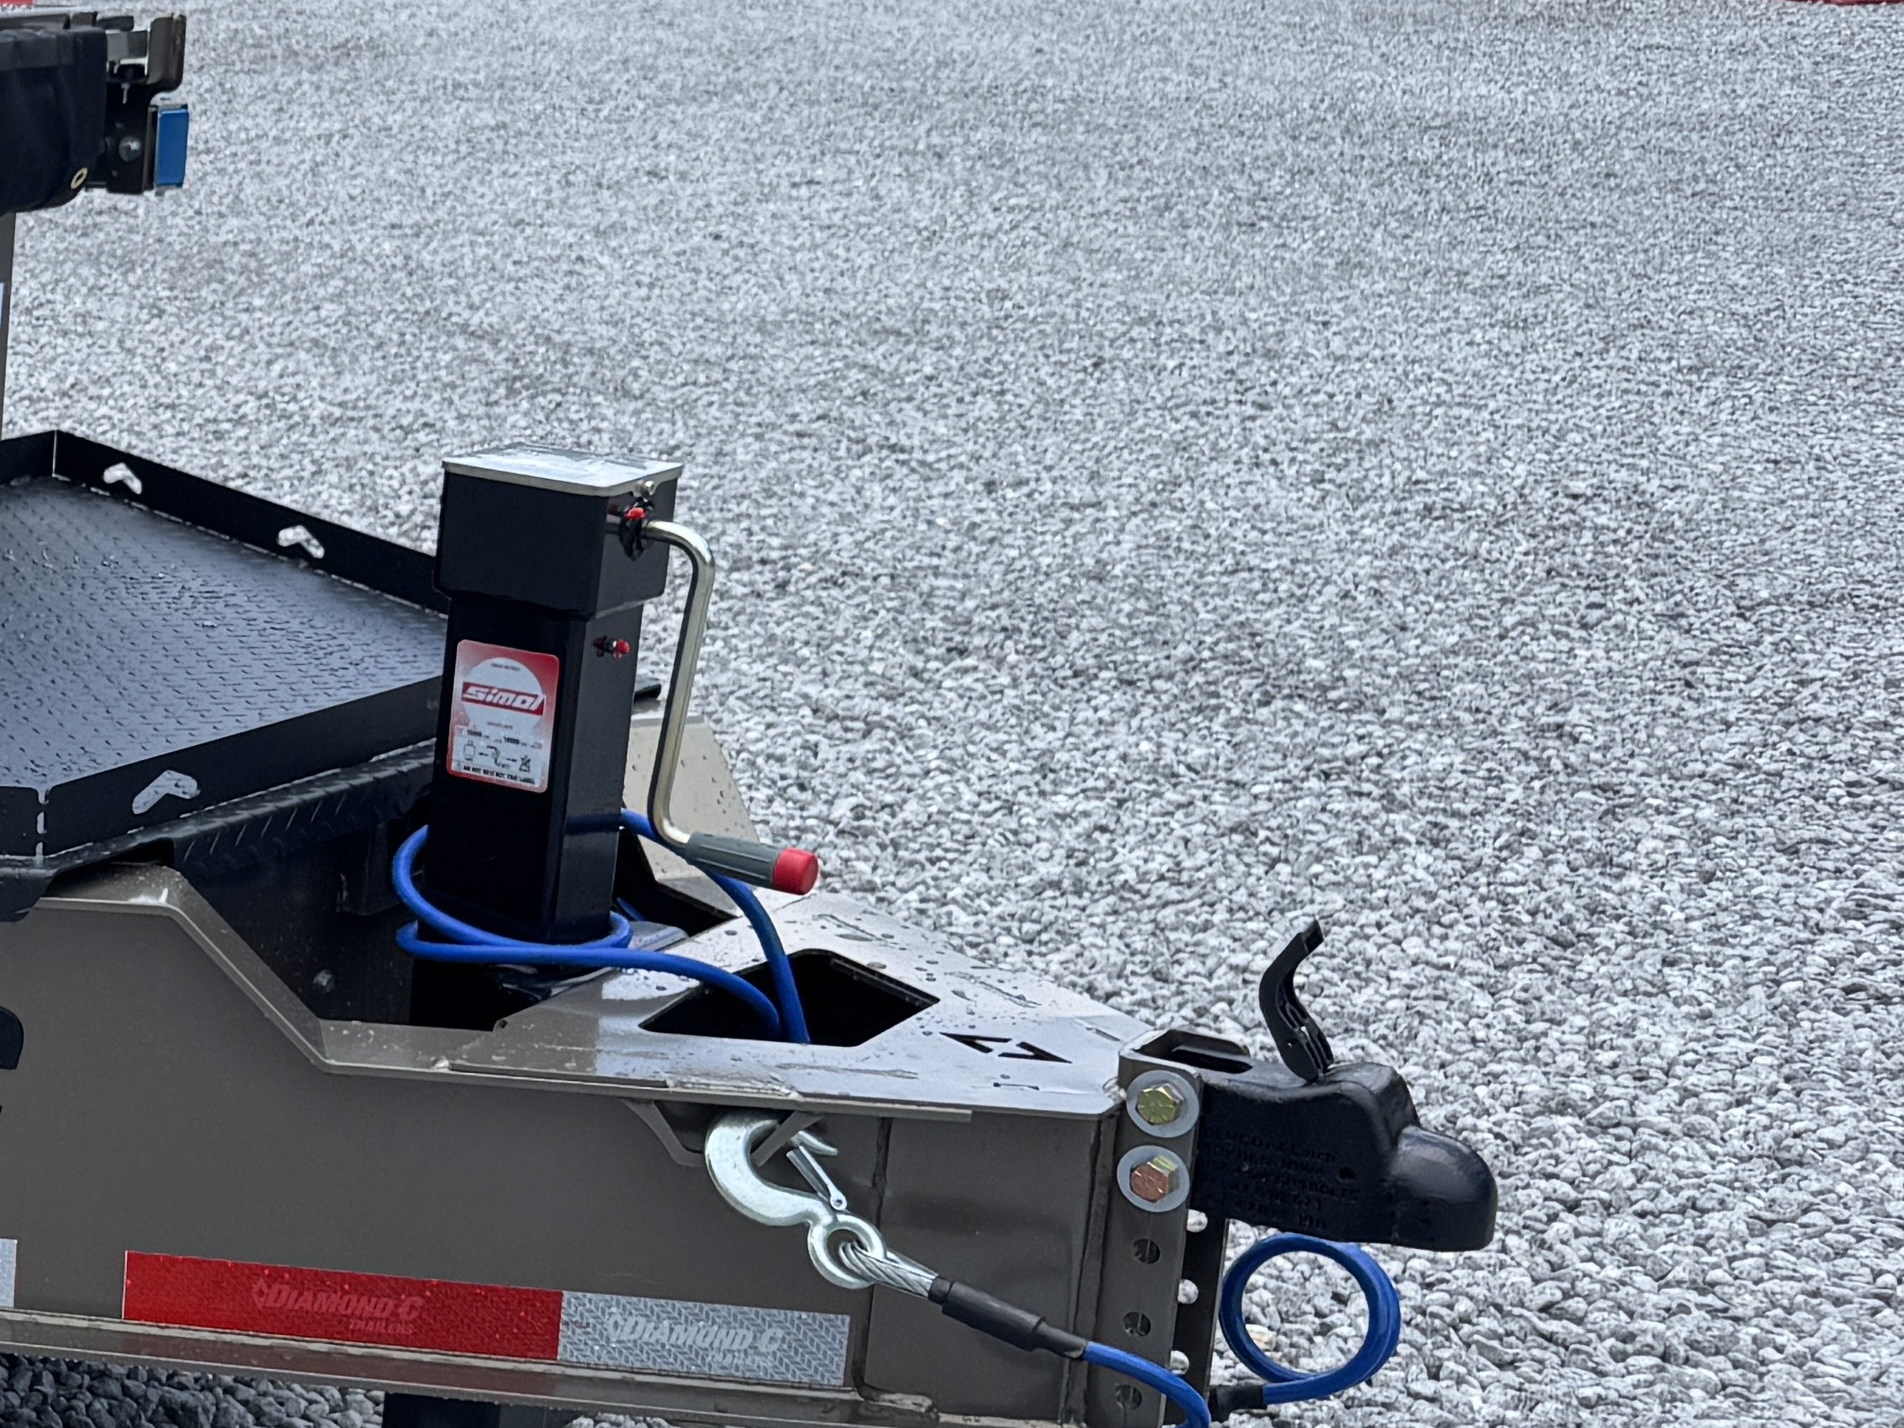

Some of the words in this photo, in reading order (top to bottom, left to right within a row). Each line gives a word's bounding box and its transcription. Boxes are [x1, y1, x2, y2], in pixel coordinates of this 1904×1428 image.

[264, 1282, 395, 1318] DIAMOND
[398, 1295, 424, 1320] C
[621, 1315, 754, 1351] DIAMOND
[759, 1327, 784, 1352] C
